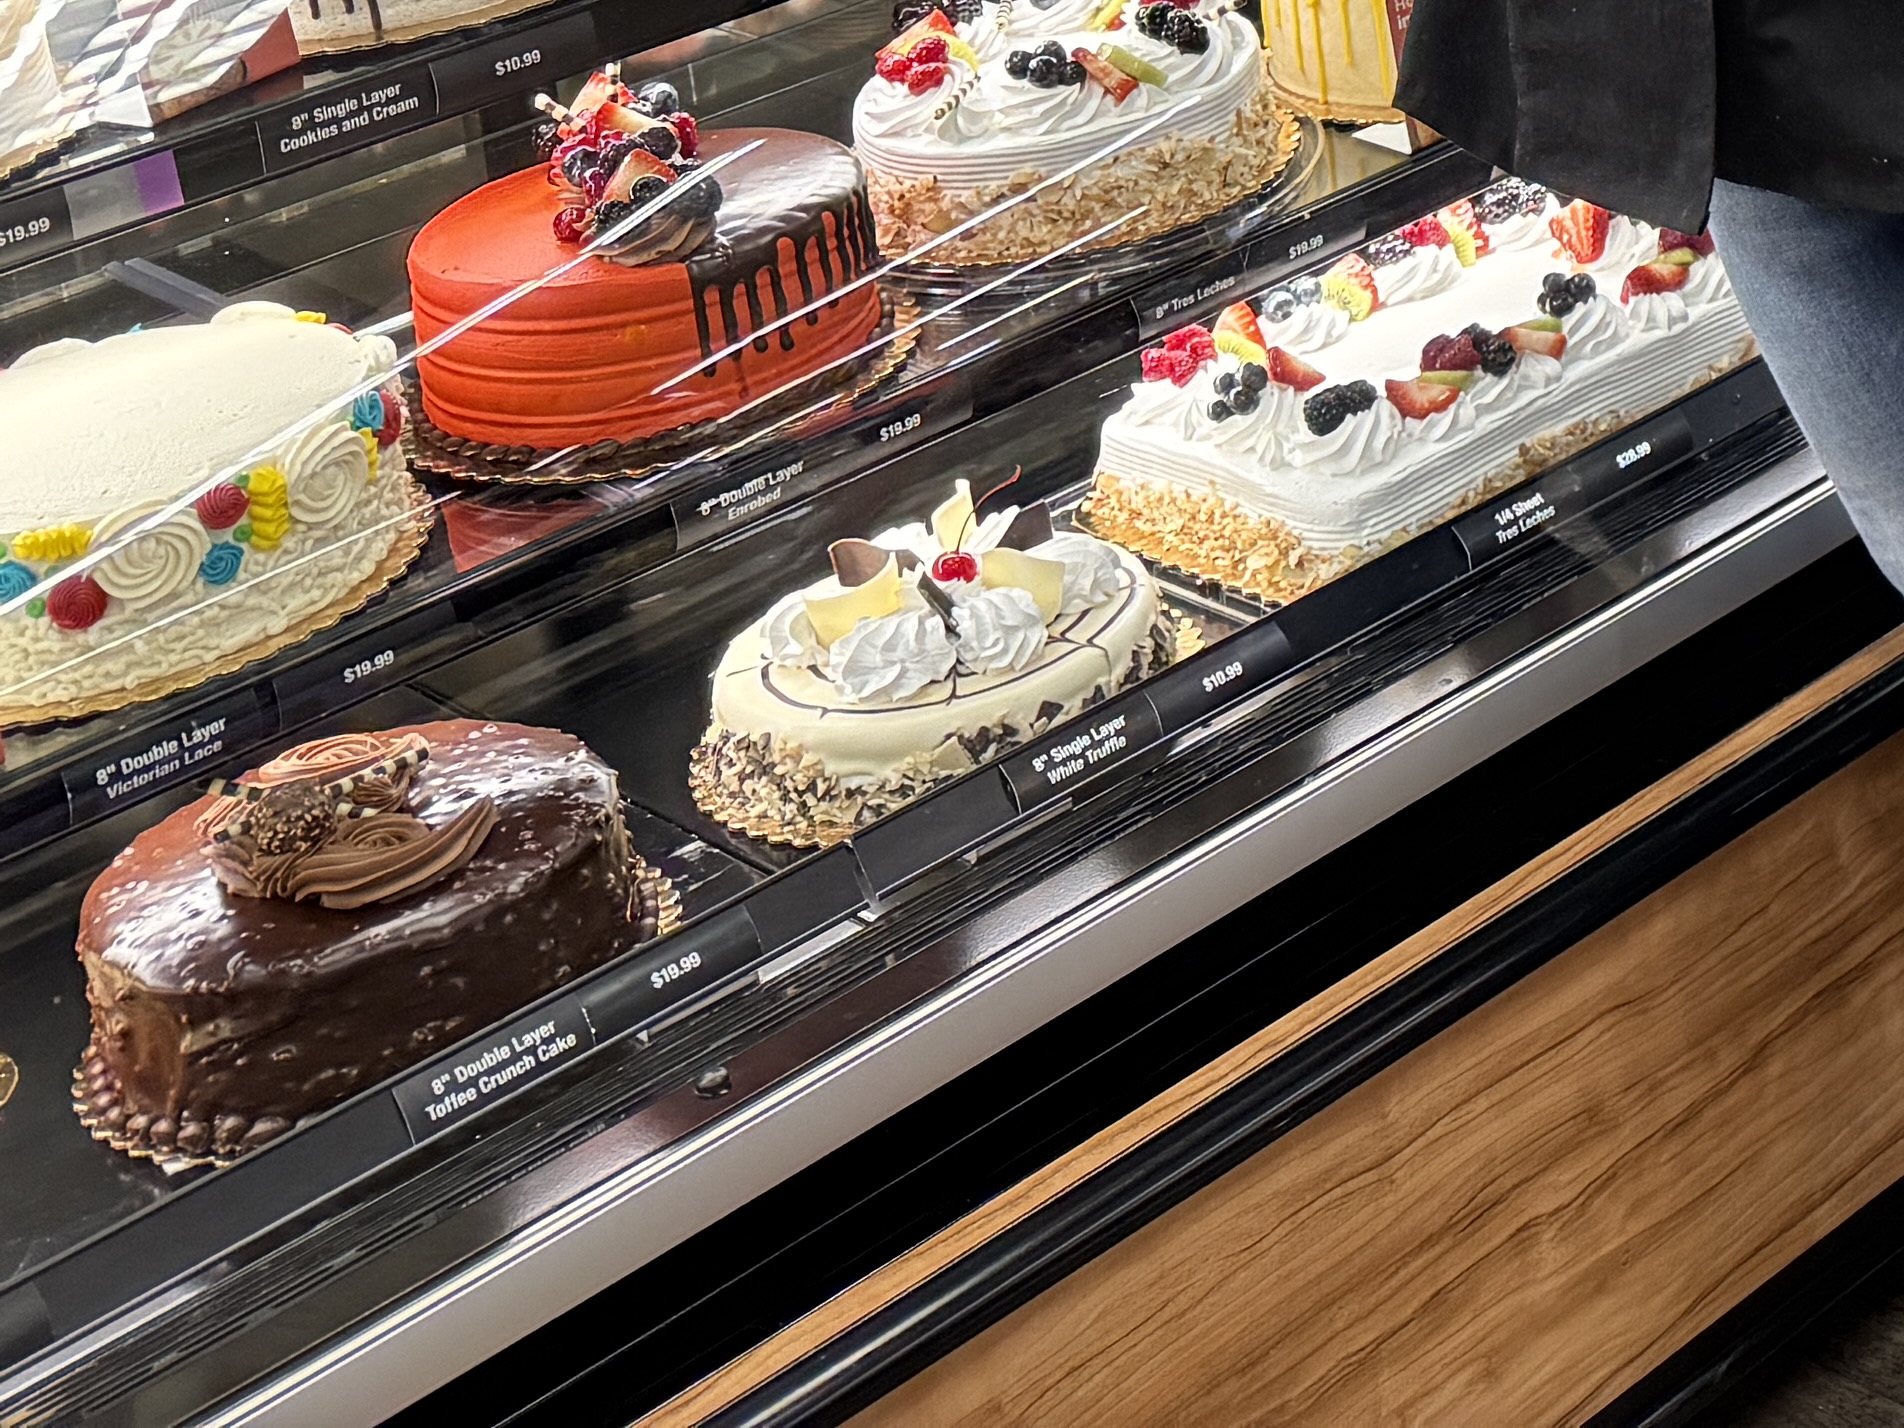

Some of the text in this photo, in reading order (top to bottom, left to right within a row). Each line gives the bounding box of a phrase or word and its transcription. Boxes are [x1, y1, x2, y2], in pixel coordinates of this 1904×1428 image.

[312, 97, 359, 124] Single
[361, 83, 403, 108] Layer
[494, 49, 541, 77] $10.99
[279, 95, 420, 154] Cookies and Cream
[1171, 293, 1196, 313] Tres
[1196, 275, 1236, 301] Leches
[1288, 235, 1324, 259] $19.99
[719, 413, 921, 508] Double Layer $19.99
[727, 487, 782, 522] Enrobed
[1494, 508, 1514, 527] 1/4
[1511, 492, 1546, 517] Sheet
[1495, 504, 1556, 545] Tres Leches
[120, 740, 180, 777] Double
[180, 717, 227, 749] Layer
[344, 649, 395, 684] $19.99
[1050, 734, 1091, 764] Single
[1091, 713, 1128, 741] Layer
[1202, 661, 1243, 693] $10.99
[105, 739, 223, 800] Victorian Lace
[1047, 734, 1128, 785] White Truffle
[454, 1046, 511, 1084] Double
[511, 1020, 557, 1051] Layer
[650, 951, 702, 989] $19.99
[424, 1033, 577, 1122] Toffee Crunch Cake
